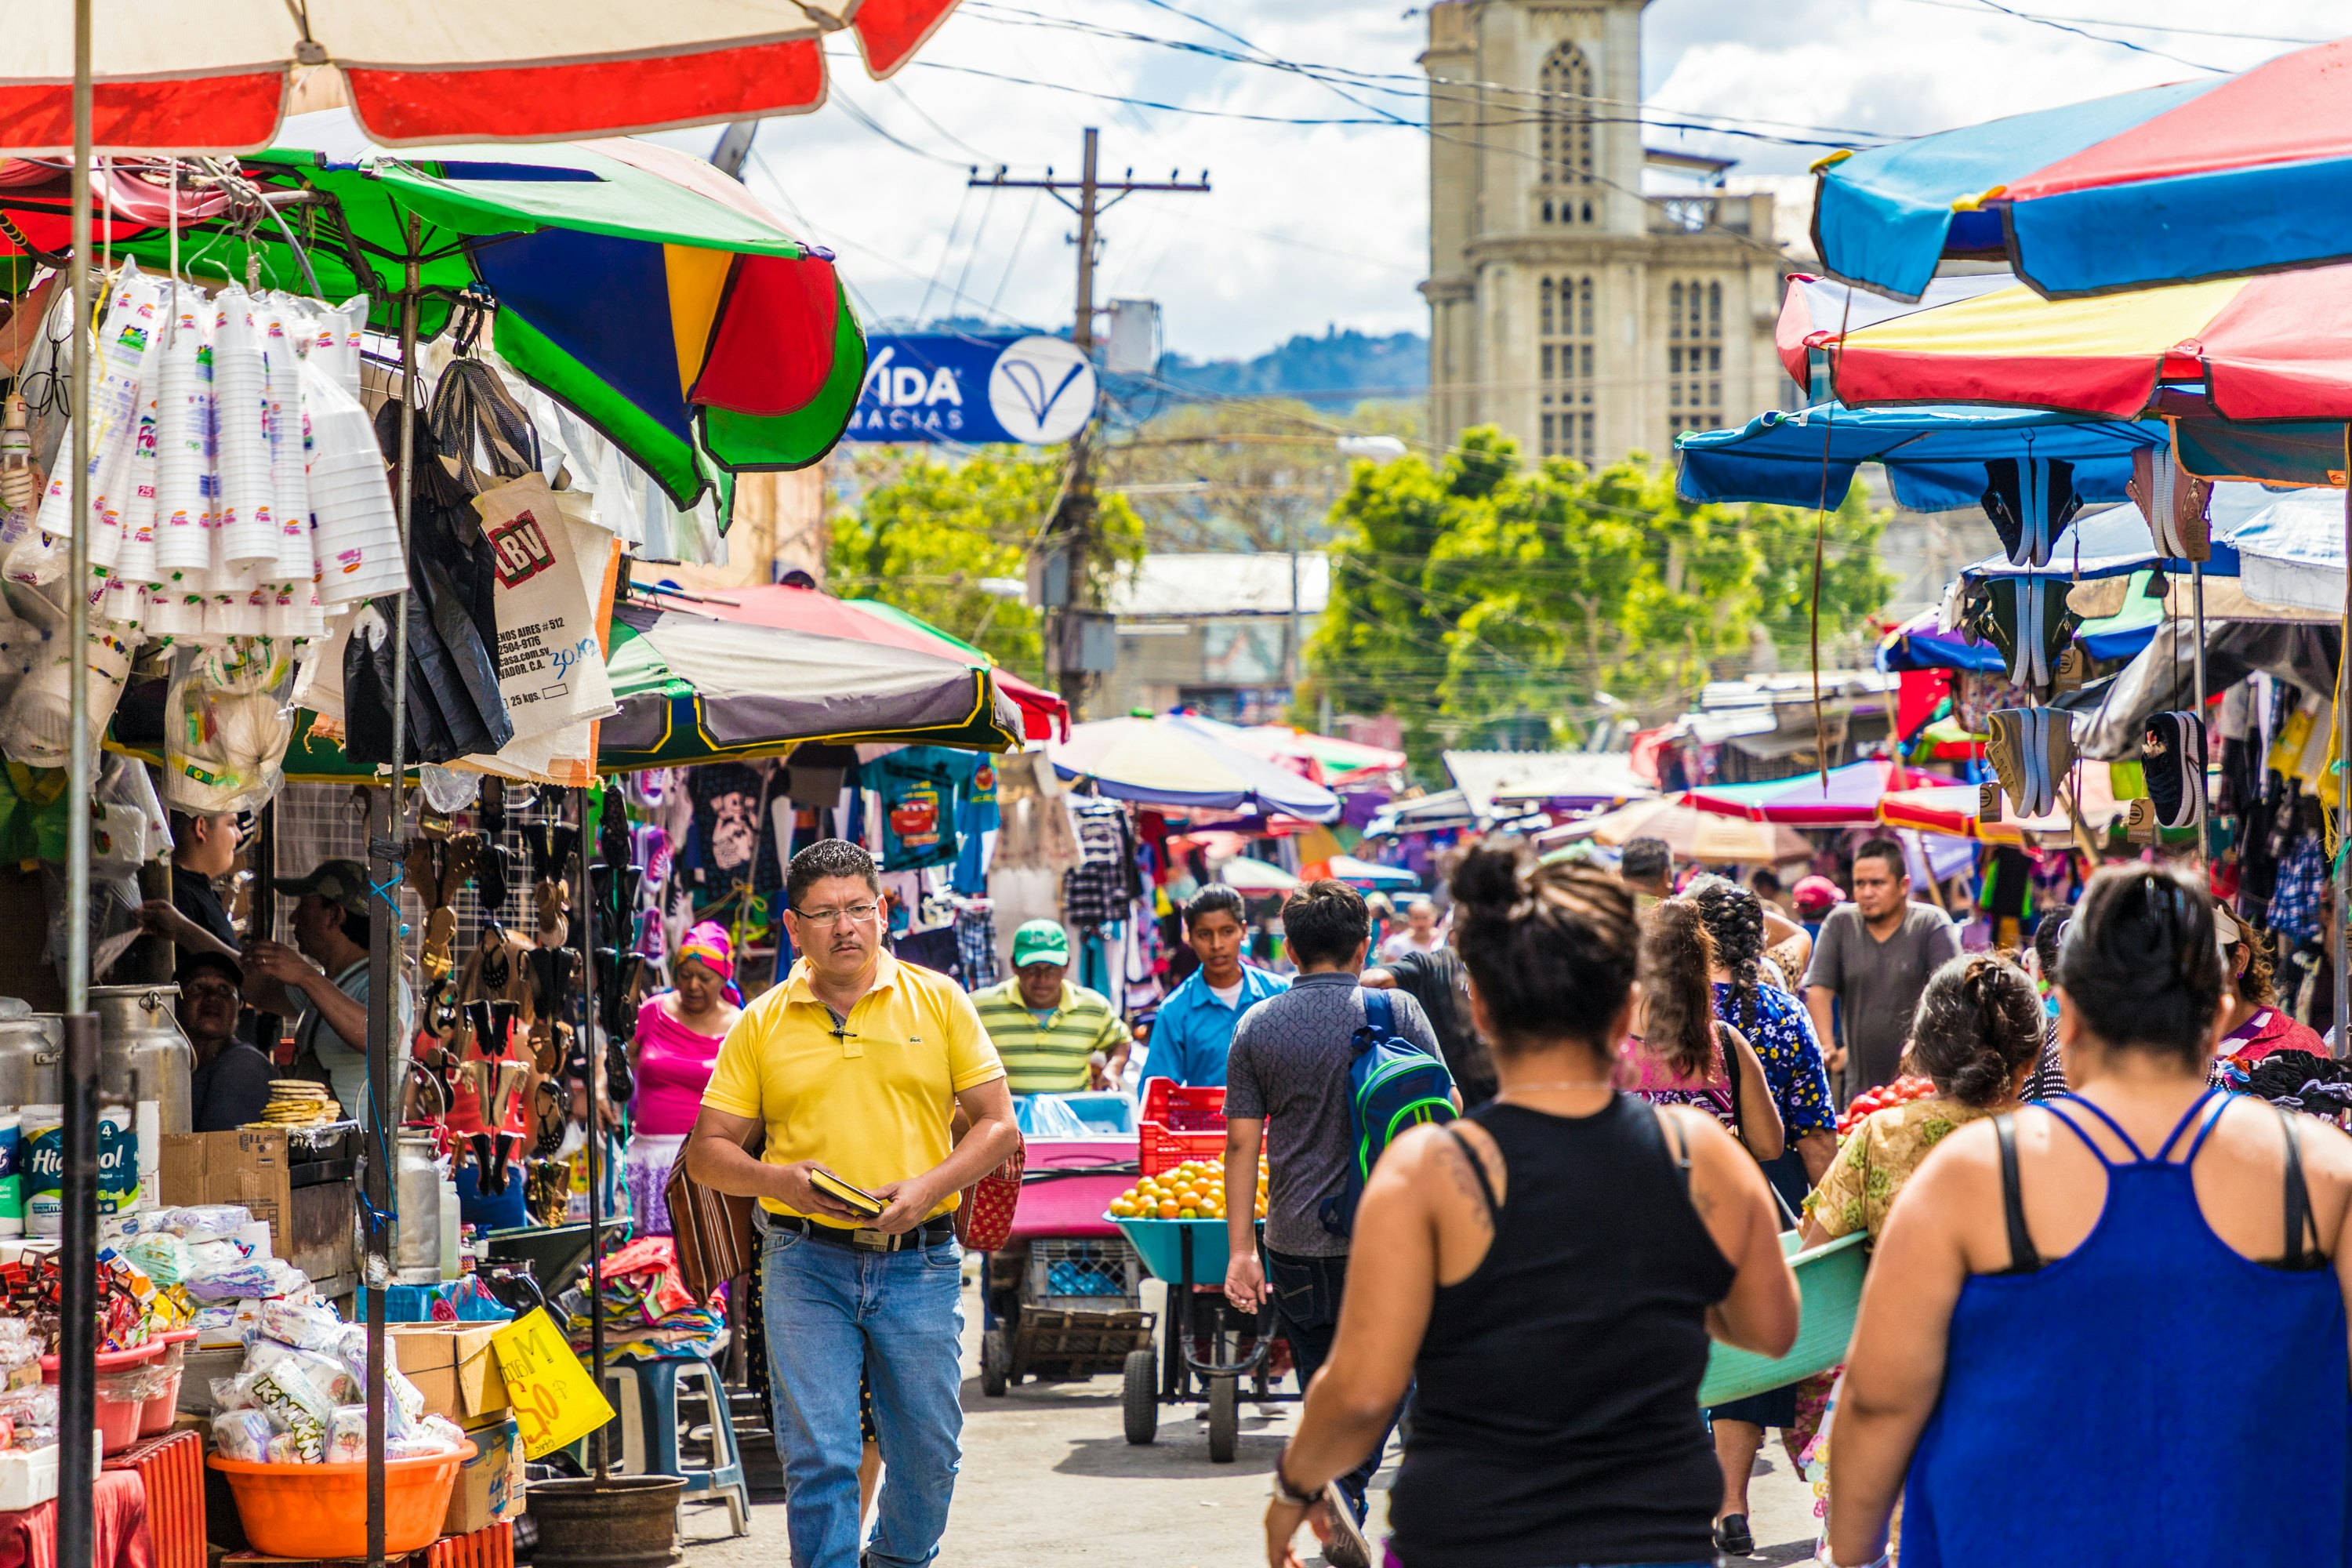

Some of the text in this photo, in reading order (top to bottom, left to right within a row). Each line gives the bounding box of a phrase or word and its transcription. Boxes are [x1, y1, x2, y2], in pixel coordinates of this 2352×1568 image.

[517, 623, 541, 639] AIRES
[529, 659, 546, 672] C.A.
[510, 691, 541, 706] 25 kgs.
[102, 1125, 111, 1136] 4
